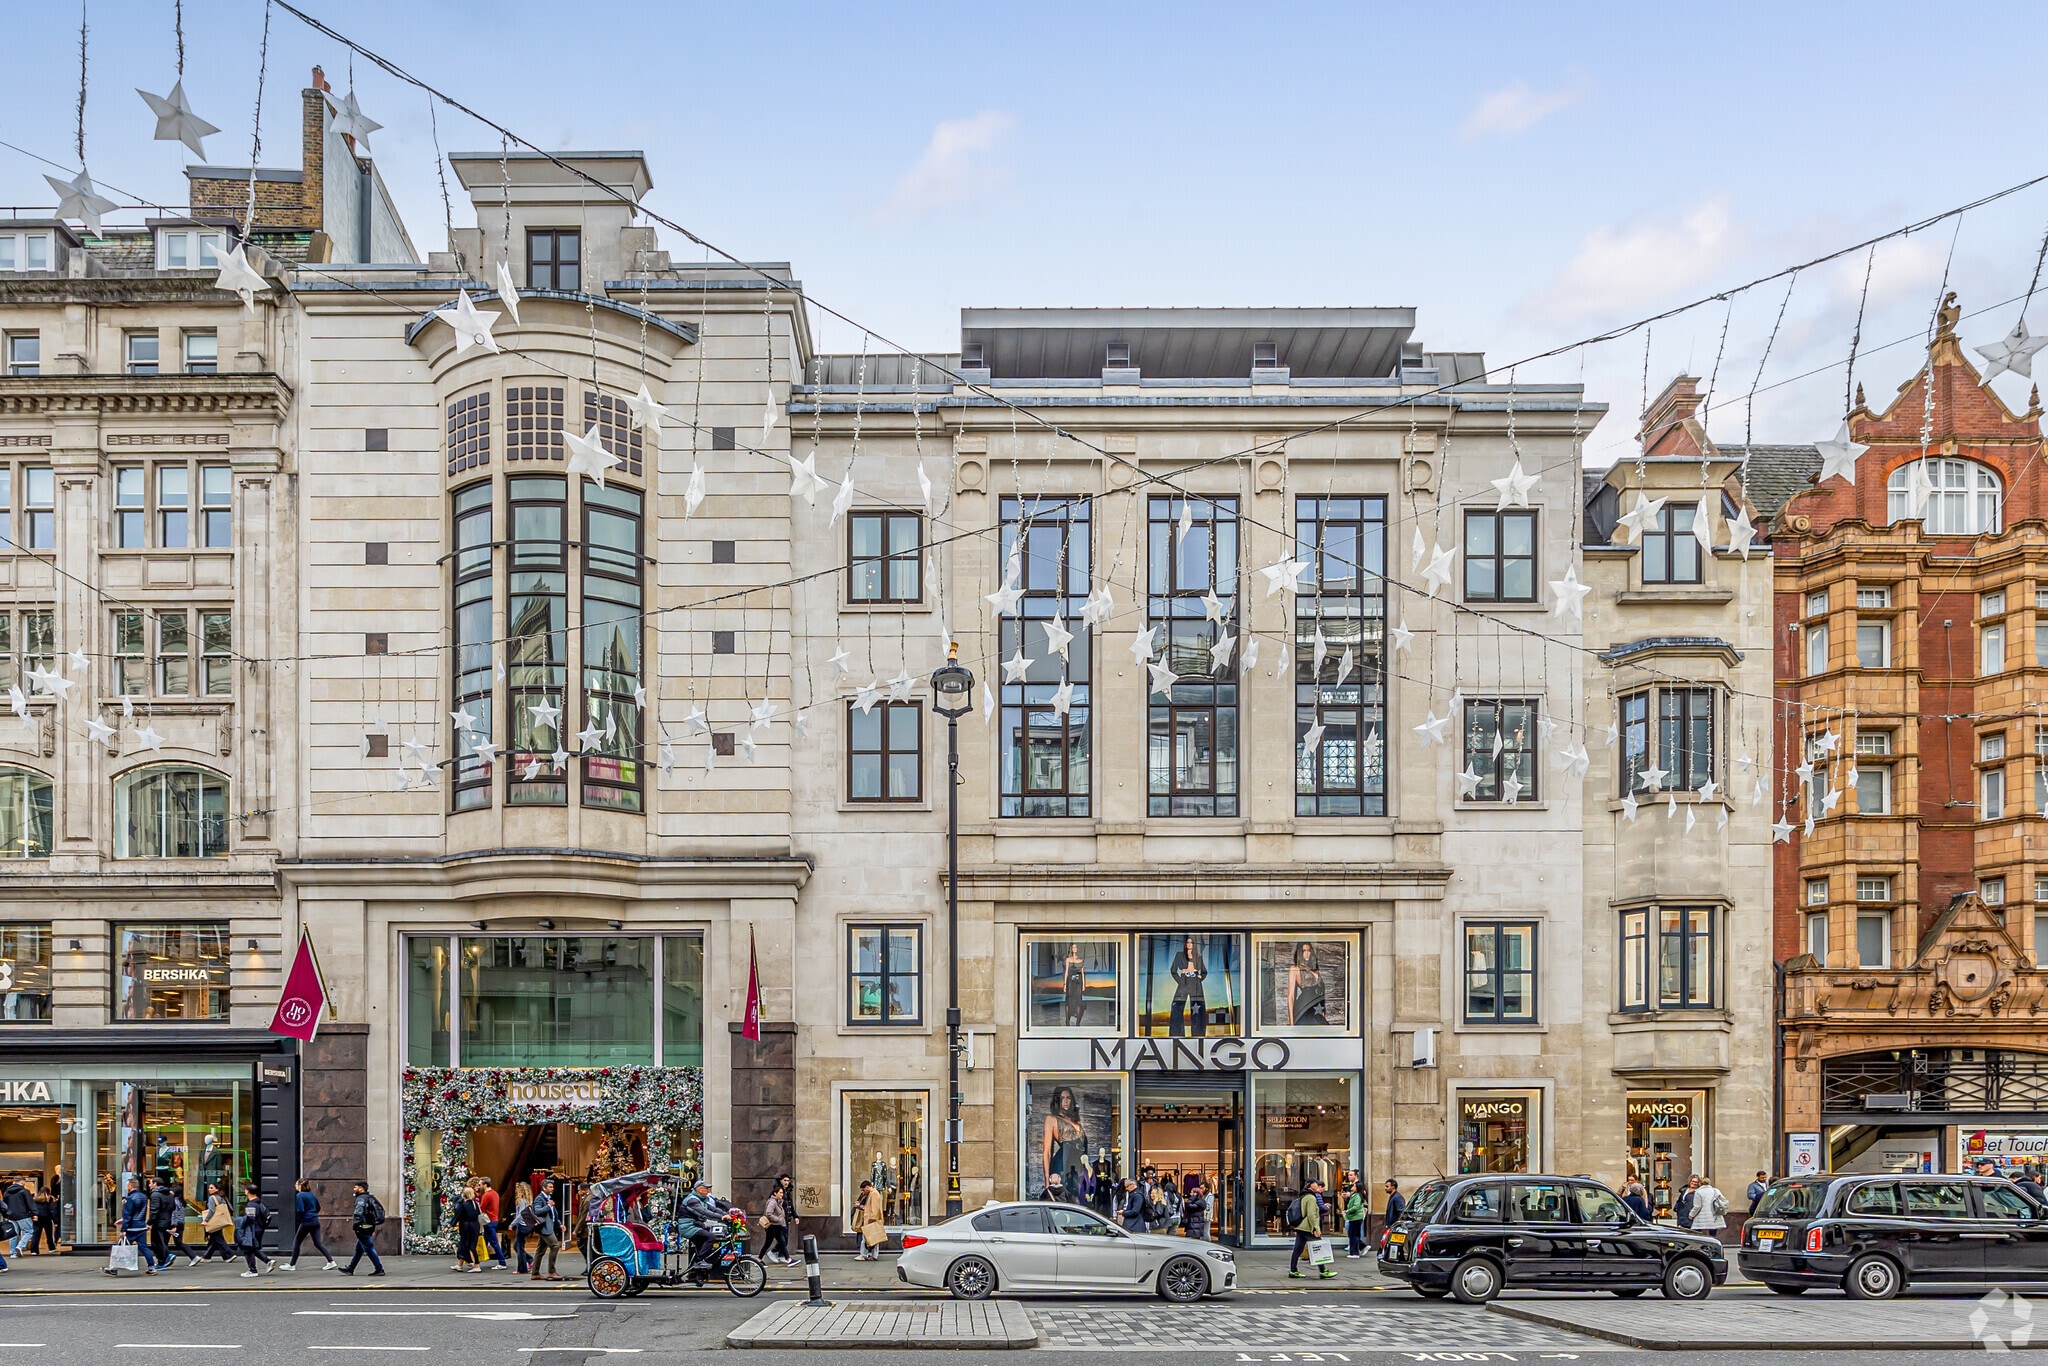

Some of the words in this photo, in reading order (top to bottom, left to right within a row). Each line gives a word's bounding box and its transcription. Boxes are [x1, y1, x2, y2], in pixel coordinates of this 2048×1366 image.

[143, 969, 208, 980] BERSHKA
[1090, 1037, 1291, 1071] MANGO
[1464, 1103, 1523, 1114] MANGO
[1629, 1103, 1687, 1114] MANGO
[1235, 1352, 1351, 1362] LEFT
[1401, 1352, 1518, 1361] LOOK
